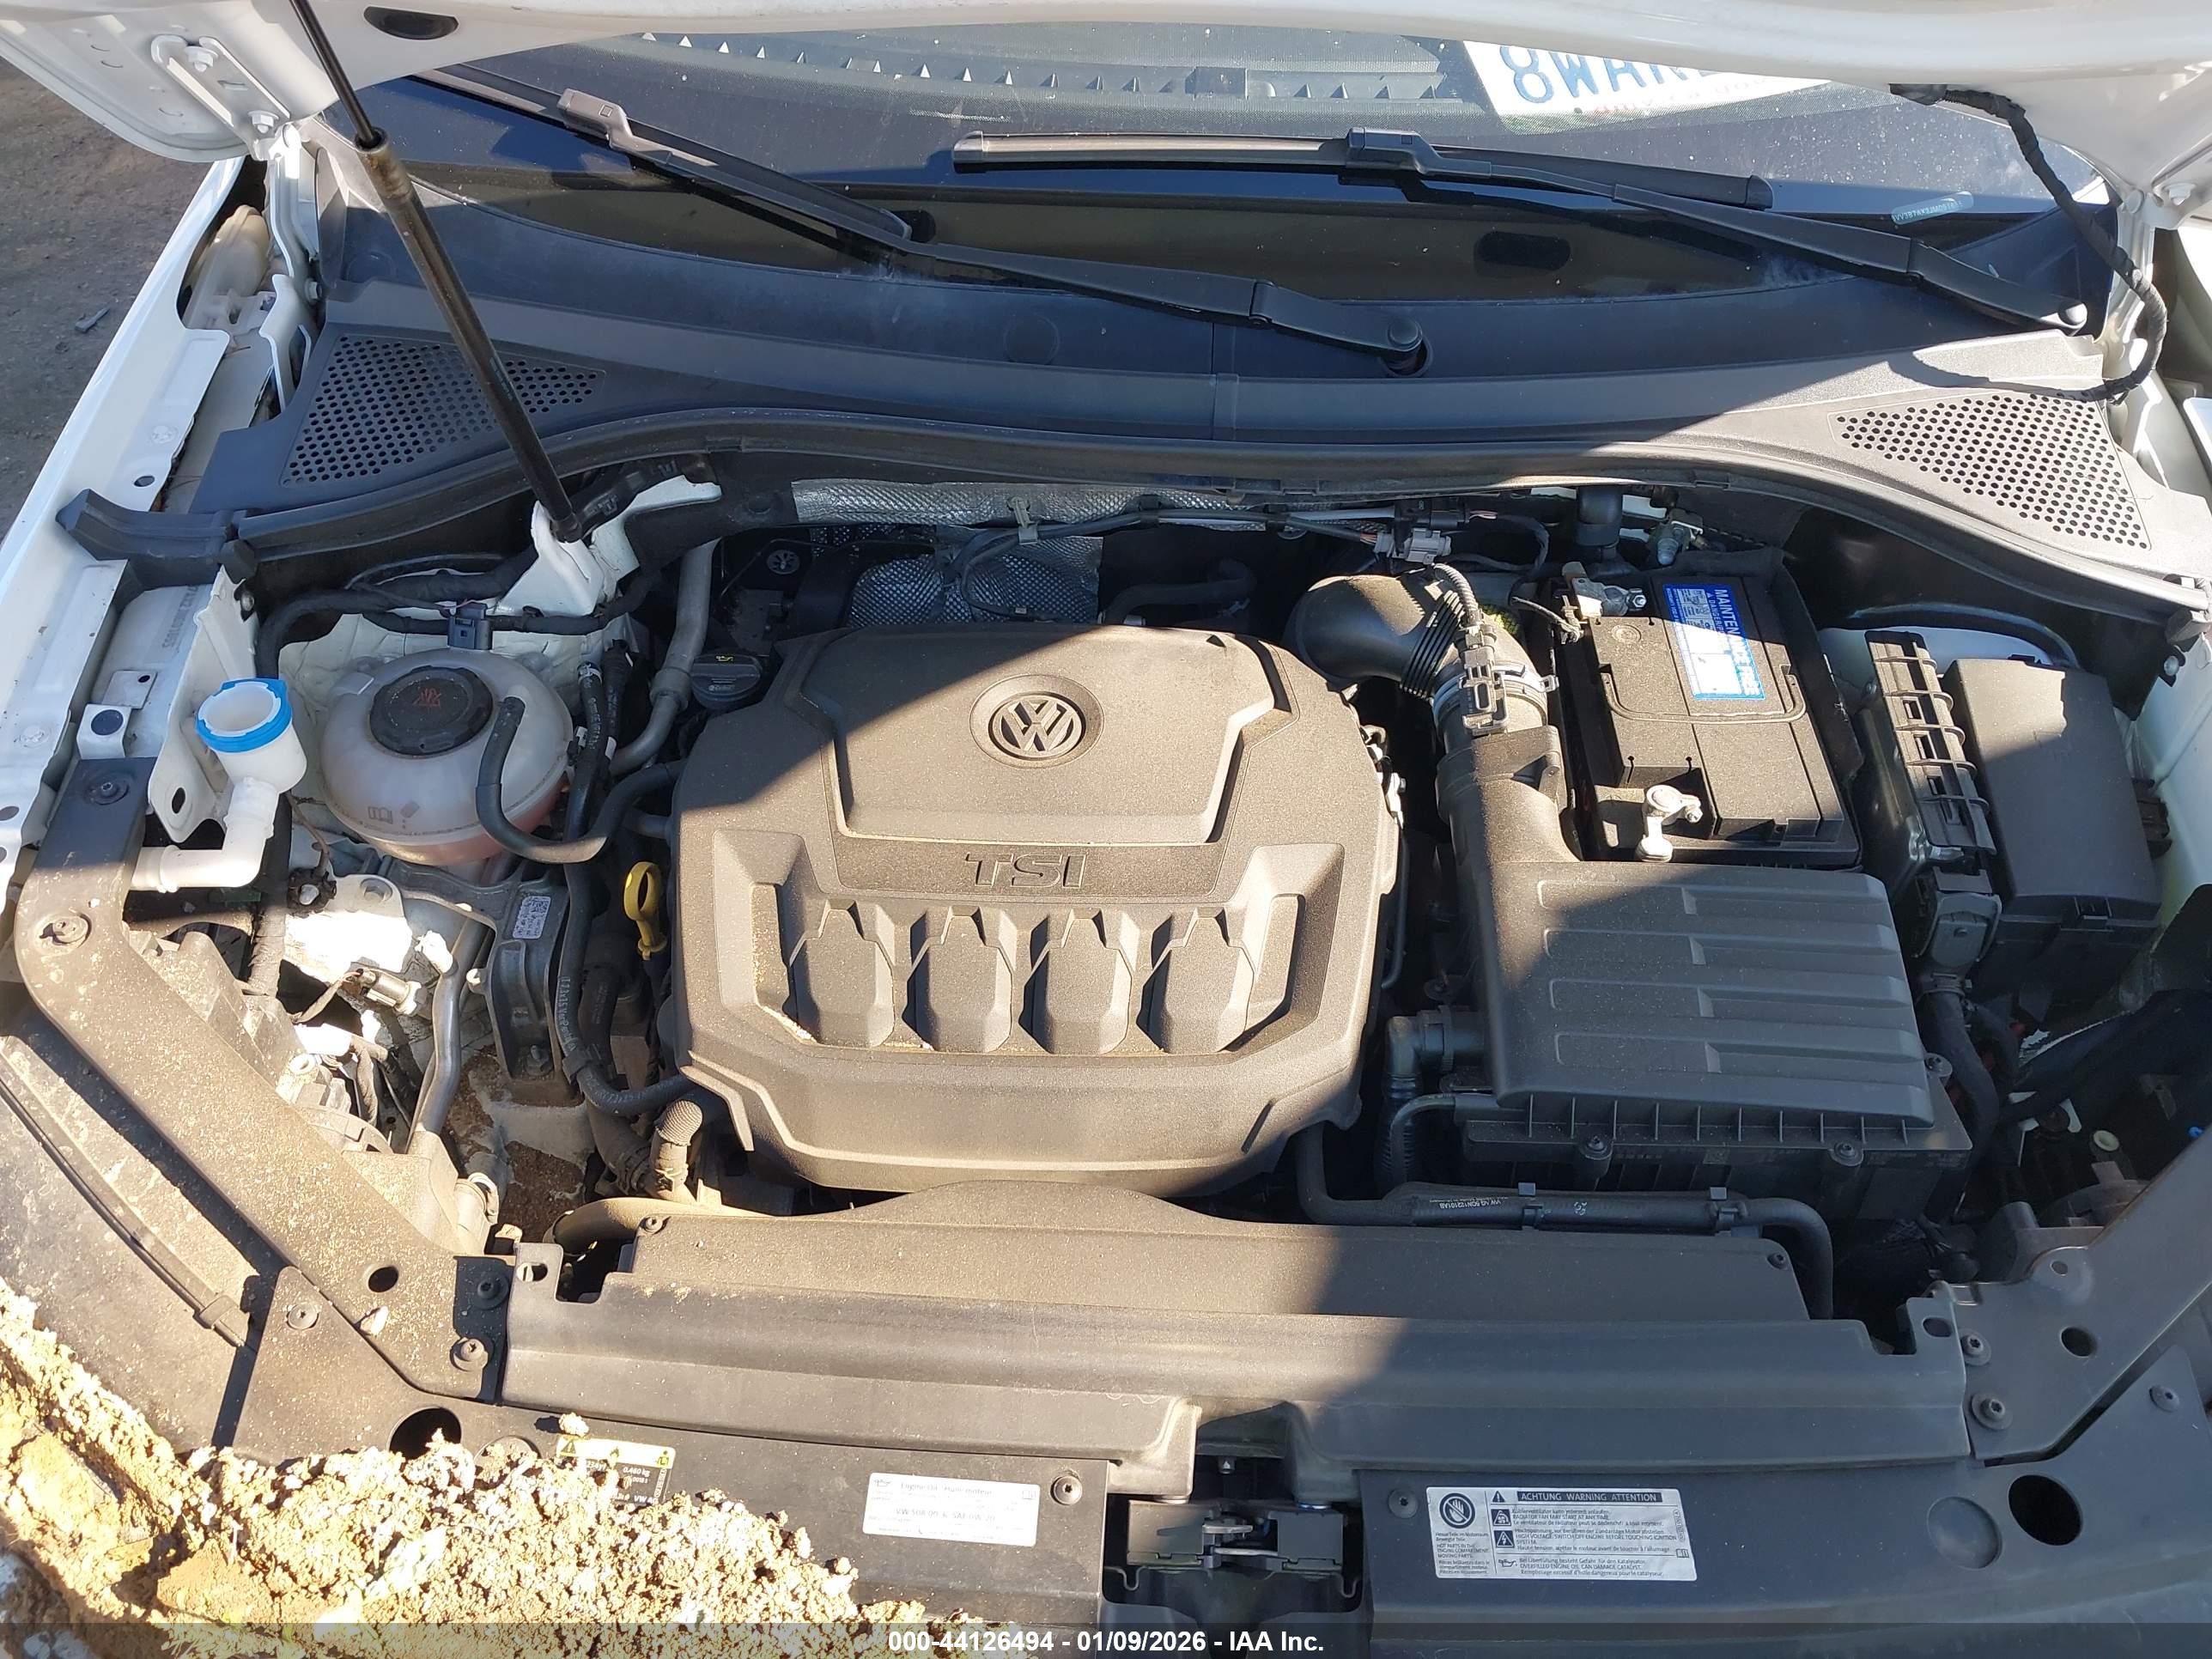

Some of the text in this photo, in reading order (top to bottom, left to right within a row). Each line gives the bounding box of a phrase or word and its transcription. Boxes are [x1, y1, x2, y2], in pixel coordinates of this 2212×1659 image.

[965, 853, 1087, 889] TSI
[1521, 1492, 1657, 1502] ACHTUNG WARNING ATTENTION
